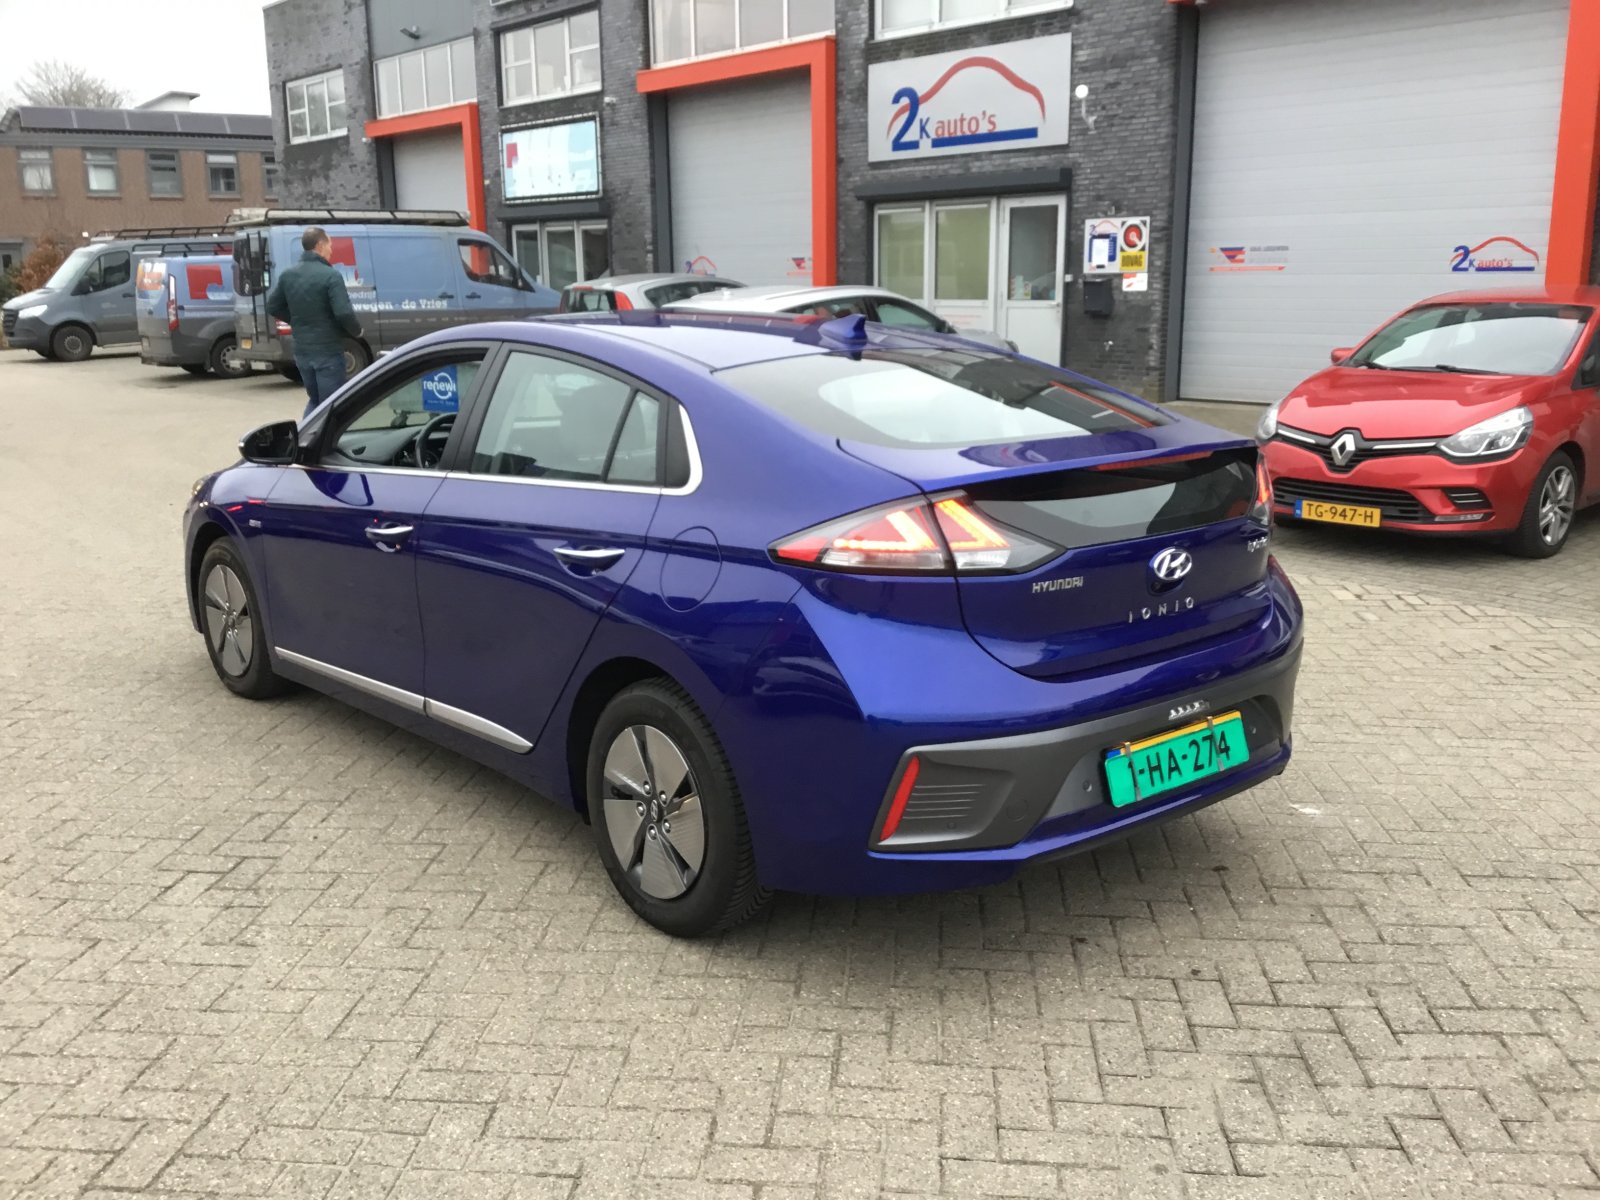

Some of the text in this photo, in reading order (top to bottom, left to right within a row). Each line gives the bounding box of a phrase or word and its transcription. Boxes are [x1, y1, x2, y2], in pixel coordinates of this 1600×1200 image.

[934, 110, 997, 138] auto's
[352, 298, 448, 312] wegen de Vries
[1306, 502, 1374, 524] TG-947-H
[1032, 576, 1084, 594] HYUNDAI
[1128, 596, 1194, 623] IONIQ
